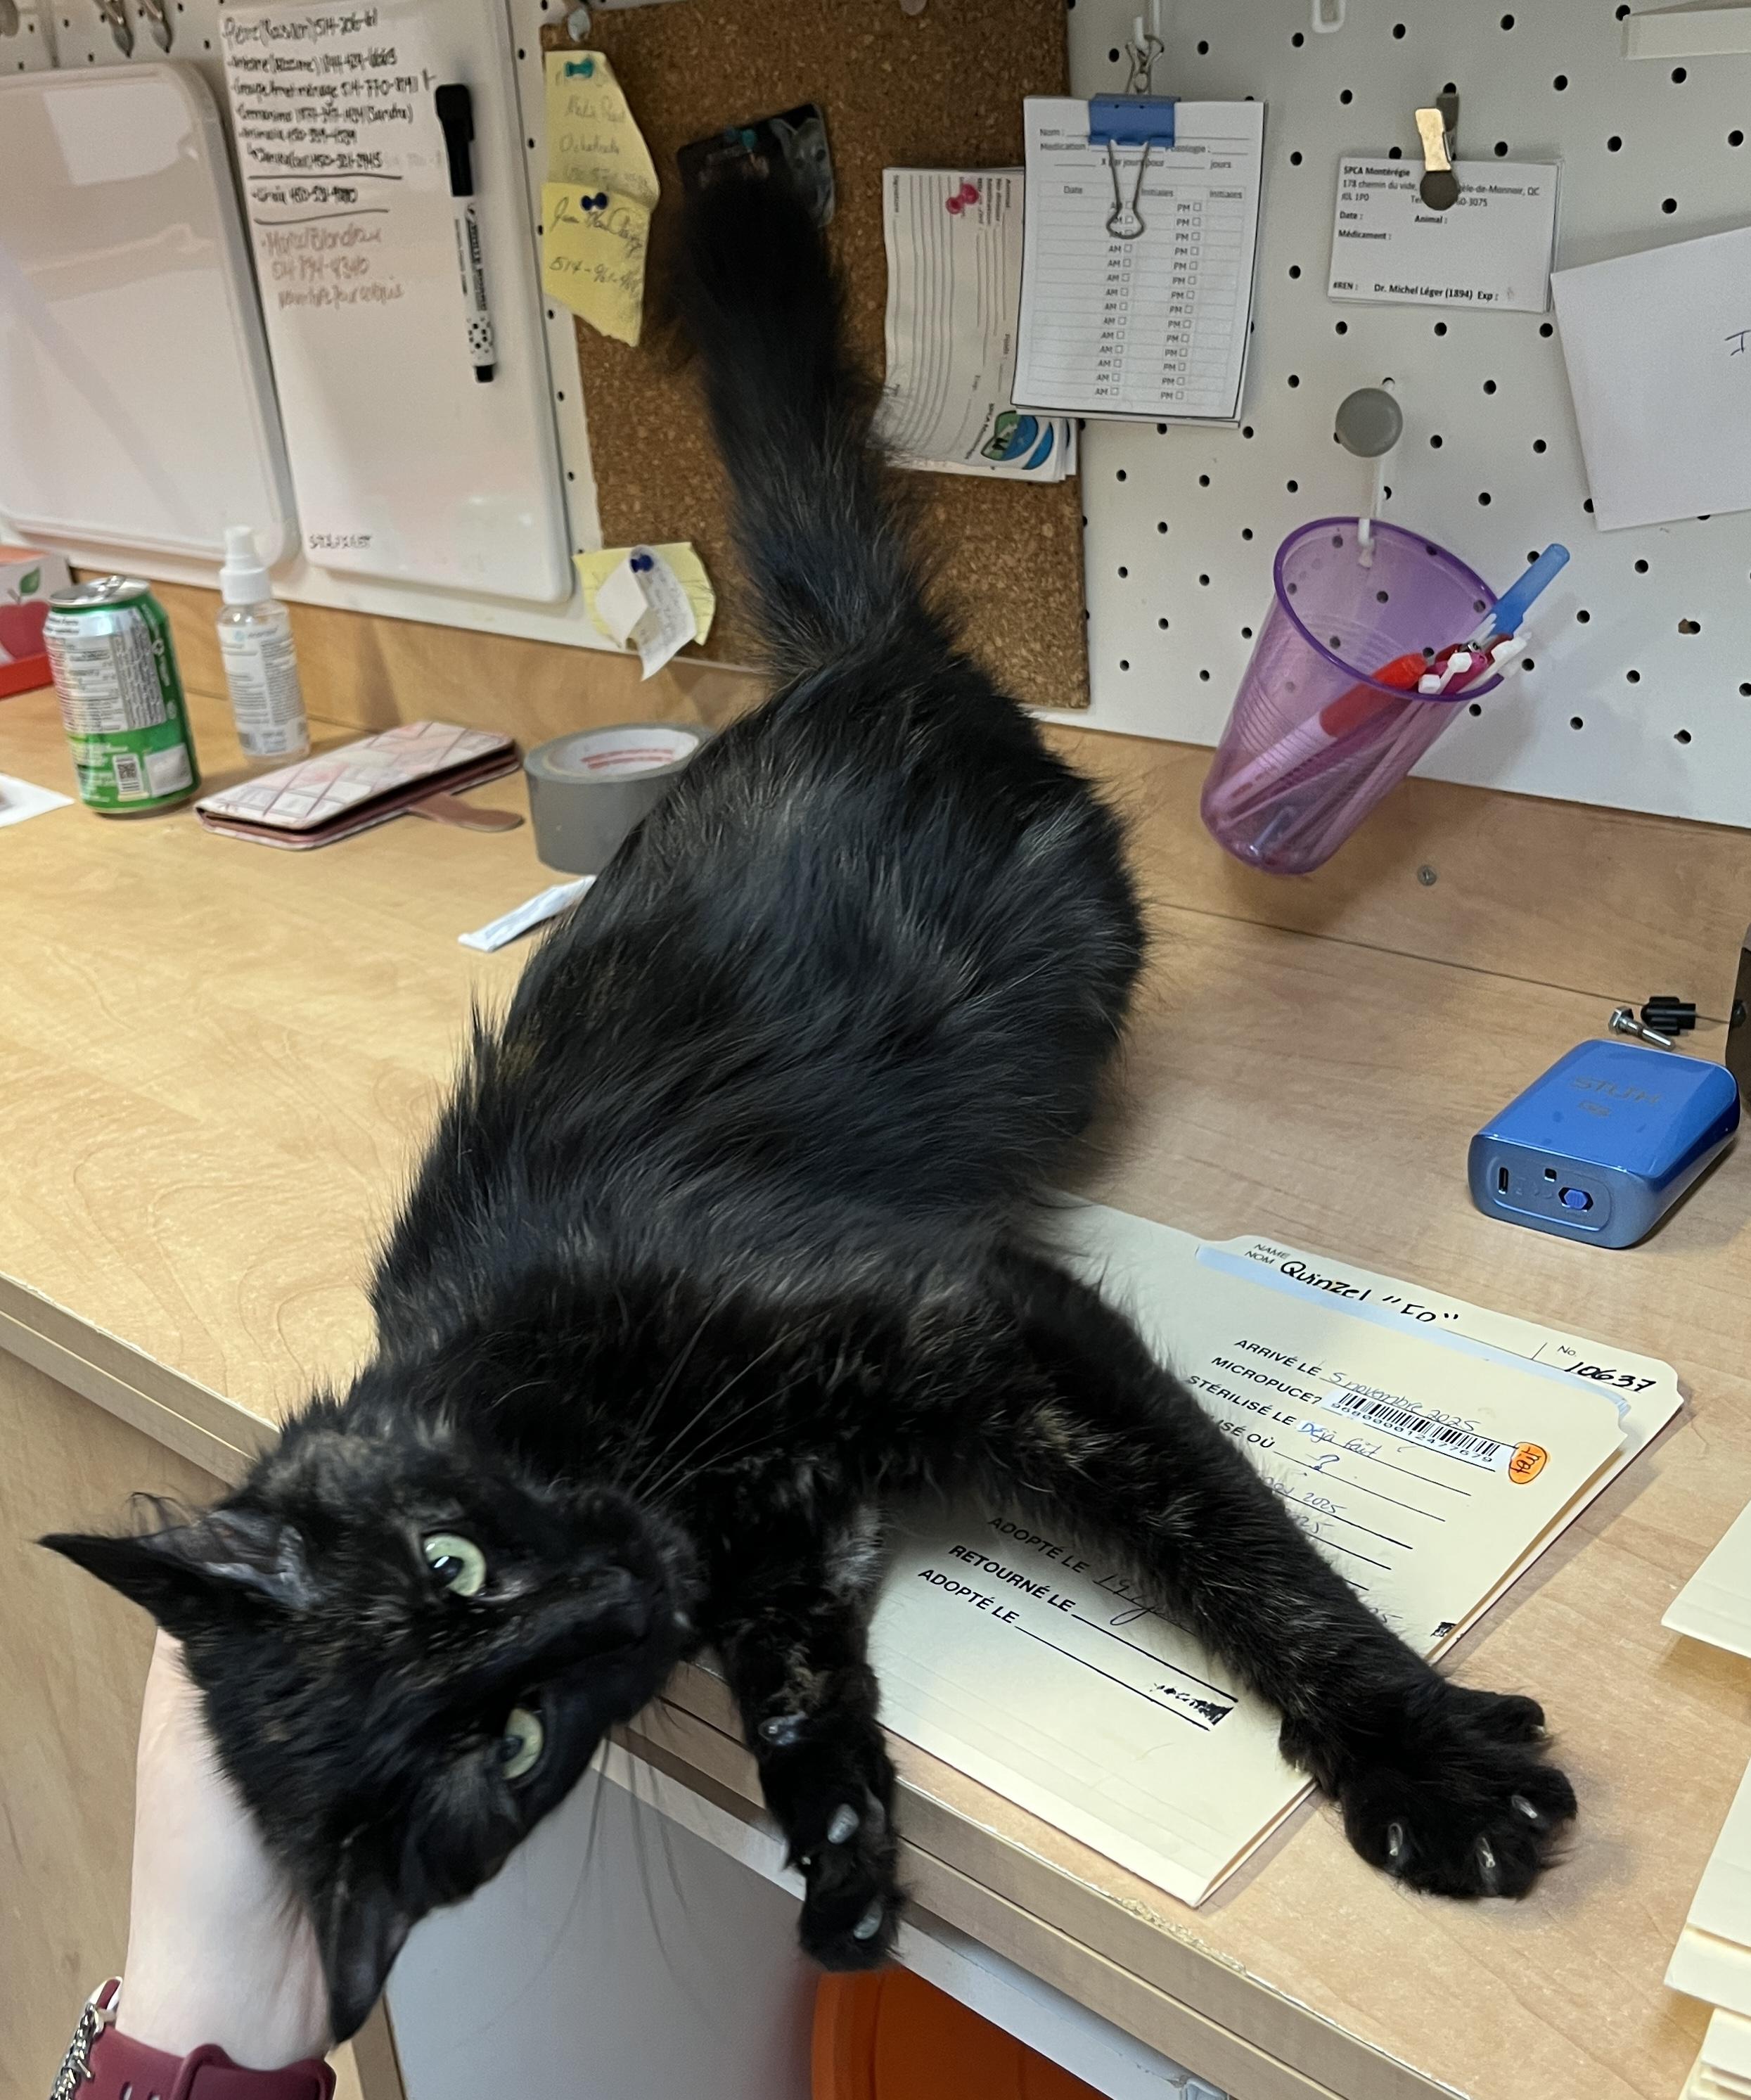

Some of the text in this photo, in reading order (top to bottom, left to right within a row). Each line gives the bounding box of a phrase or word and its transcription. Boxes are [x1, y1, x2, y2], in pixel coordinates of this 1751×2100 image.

[1343, 165, 1363, 174] SPCA
[1063, 185, 1083, 194] Date
[1387, 181, 1398, 189] du
[1177, 203, 1190, 212] PM
[1339, 211, 1357, 219] Date
[1176, 218, 1189, 226] PM
[1415, 215, 1443, 224] Animal
[1176, 233, 1188, 241] PM
[1338, 229, 1387, 240] Médicament
[1374, 284, 1387, 293] Dr.
[1389, 284, 1418, 295] Michel
[1420, 286, 1444, 297] Léger
[1445, 288, 1473, 300] (1894)
[1255, 1243, 1290, 1260] NAME
[1245, 1250, 1275, 1265] NOM
[1280, 1260, 1372, 1301] Quinzel
[1211, 1357, 1323, 1405] MICROPUCE?
[1564, 1362, 1657, 1392] 10637
[1233, 1339, 1297, 1368] ARRIVÉ
[1297, 1362, 1323, 1377] LE
[1344, 1381, 1423, 1412] novembre
[1427, 1409, 1481, 1432] 2025
[1187, 1375, 1273, 1416] STÉRILISÉ
[1271, 1411, 1297, 1427] LE
[1302, 1492, 1347, 1513] 2025
[987, 1516, 1064, 1561] ADOPTÉ
[1061, 1554, 1090, 1574] LE
[948, 1544, 1052, 1601] RETOURNÉ
[1048, 1593, 1077, 1613] LE
[918, 1568, 1020, 1625] ADOPTÉ LE
